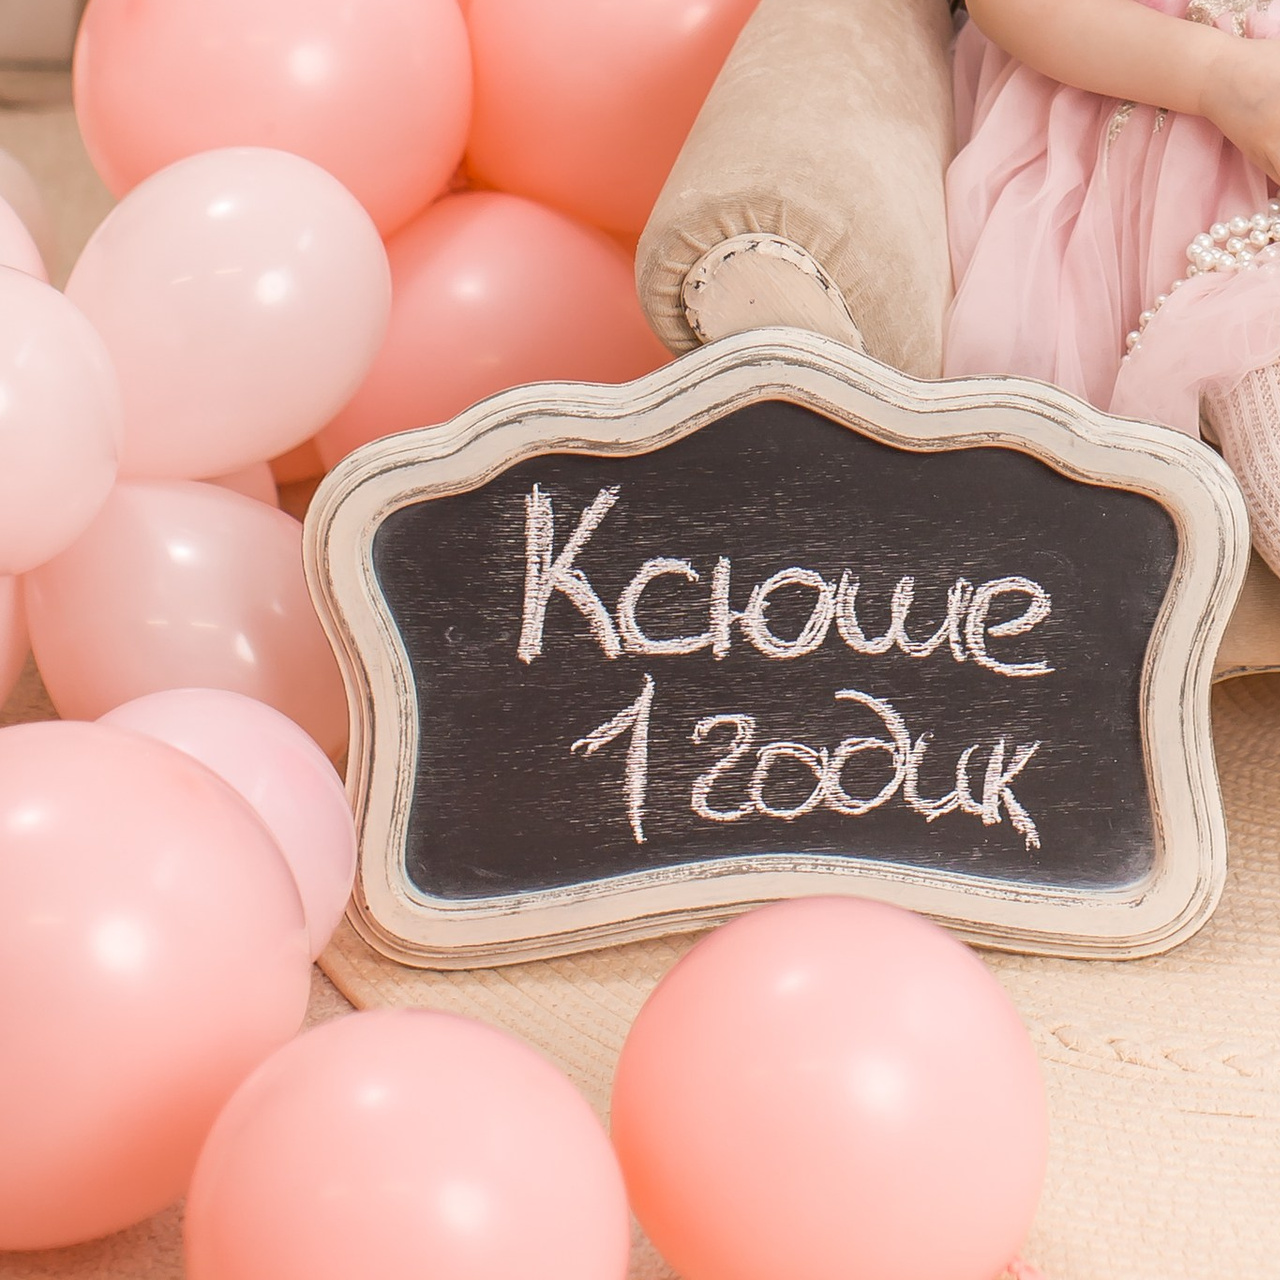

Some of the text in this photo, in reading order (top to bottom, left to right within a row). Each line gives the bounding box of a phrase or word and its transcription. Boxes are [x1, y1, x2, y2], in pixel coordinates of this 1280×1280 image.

[515, 483, 1055, 677] Ксюше
[570, 673, 1042, 851] 1 годик
